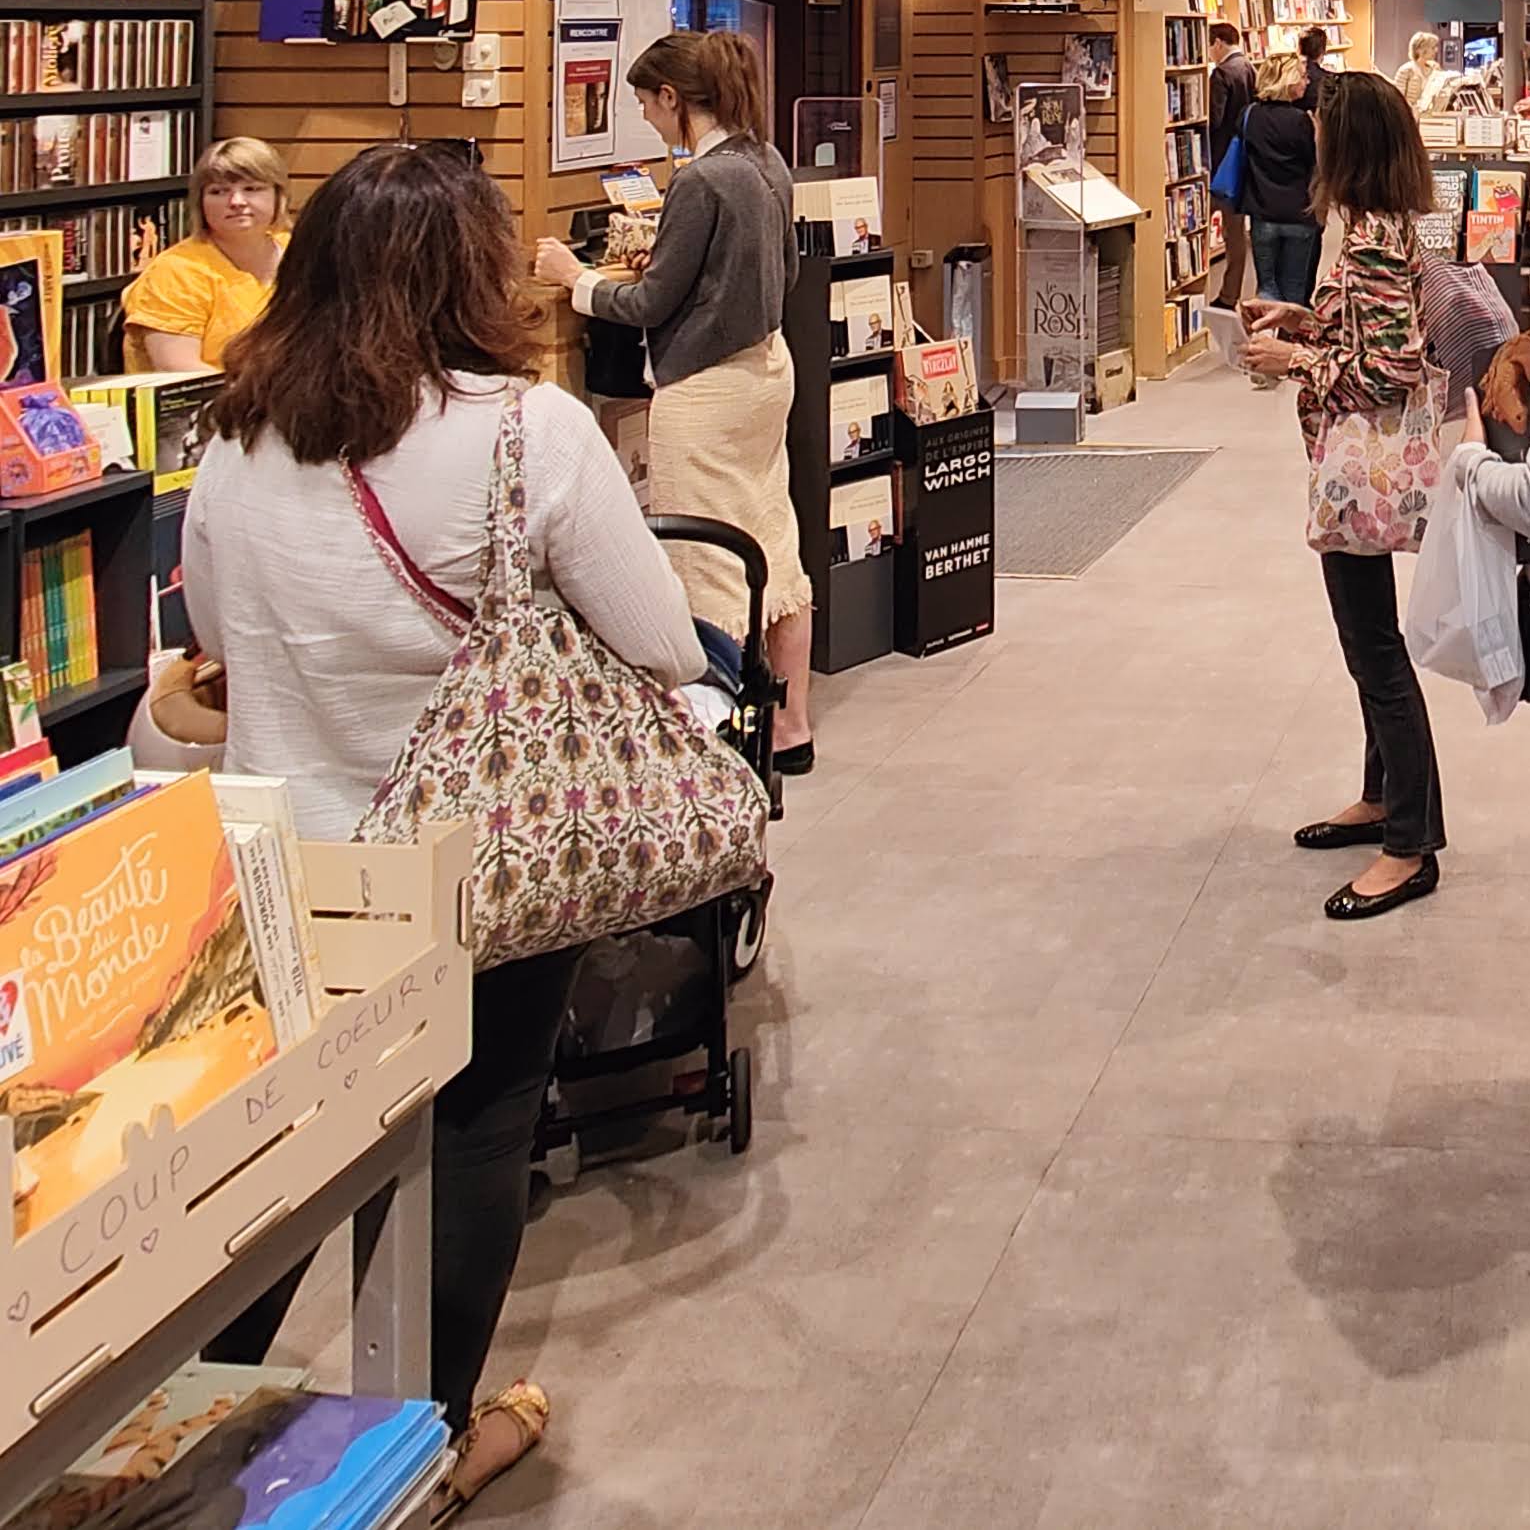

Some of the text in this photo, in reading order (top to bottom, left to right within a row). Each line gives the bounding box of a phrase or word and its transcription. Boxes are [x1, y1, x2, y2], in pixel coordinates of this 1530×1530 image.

[1417, 220, 1453, 228] WORLD
[1471, 214, 1504, 225] TINTIN
[1418, 236, 1452, 249] 2024
[1036, 291, 1087, 315] NOM
[1034, 308, 1089, 339] ROSE
[924, 451, 991, 478] LARGO
[924, 465, 991, 491] WINCH
[925, 533, 991, 563] VAN HAMME
[925, 547, 991, 580] BERTHET
[33, 832, 168, 974] Beauté
[24, 916, 169, 1047] Monde
[59, 973, 424, 1275] COUP DE COEUR
